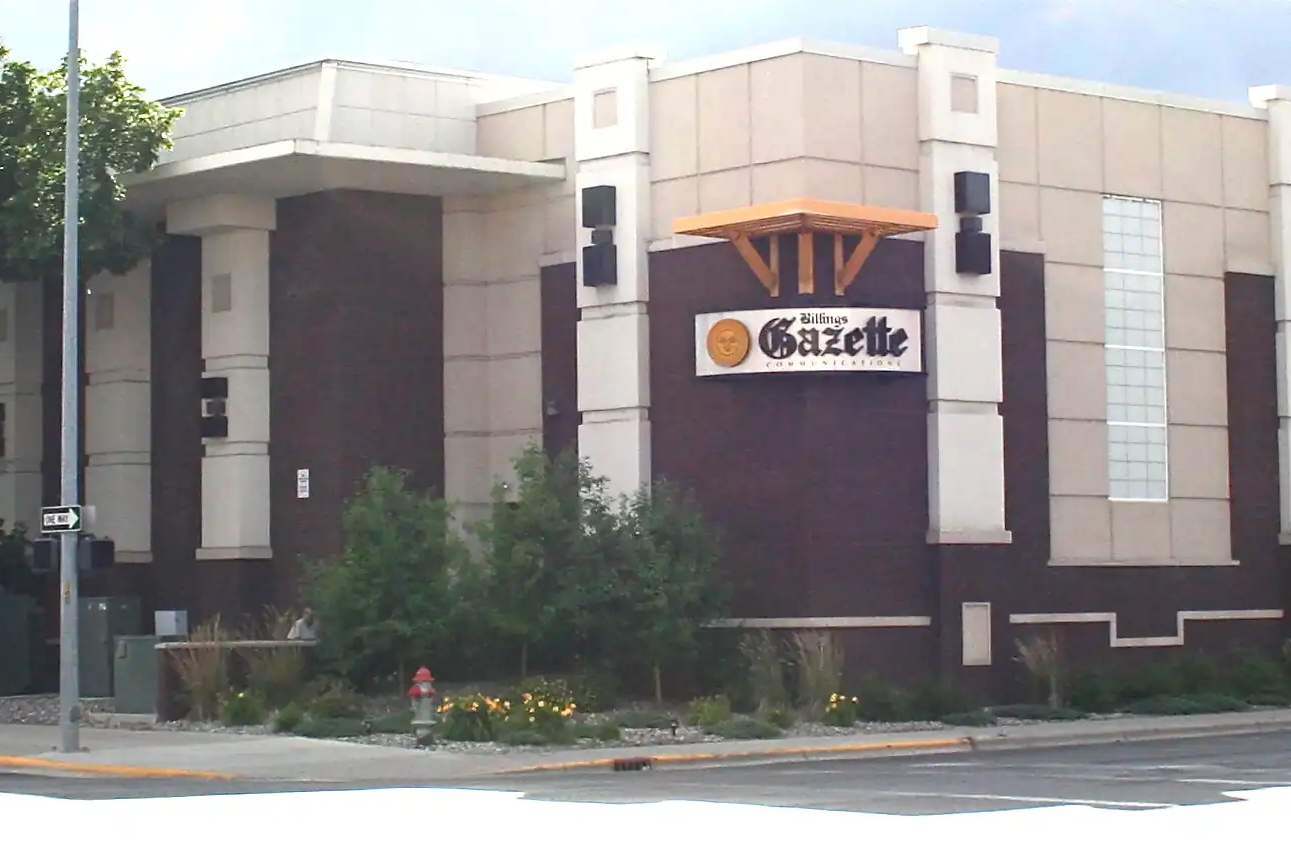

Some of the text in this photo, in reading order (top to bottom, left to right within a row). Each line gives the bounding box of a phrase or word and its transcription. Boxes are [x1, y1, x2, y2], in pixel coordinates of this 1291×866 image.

[799, 312, 848, 328] Billings
[759, 315, 909, 360] Gazette
[45, 514, 69, 525] ONE WAY
